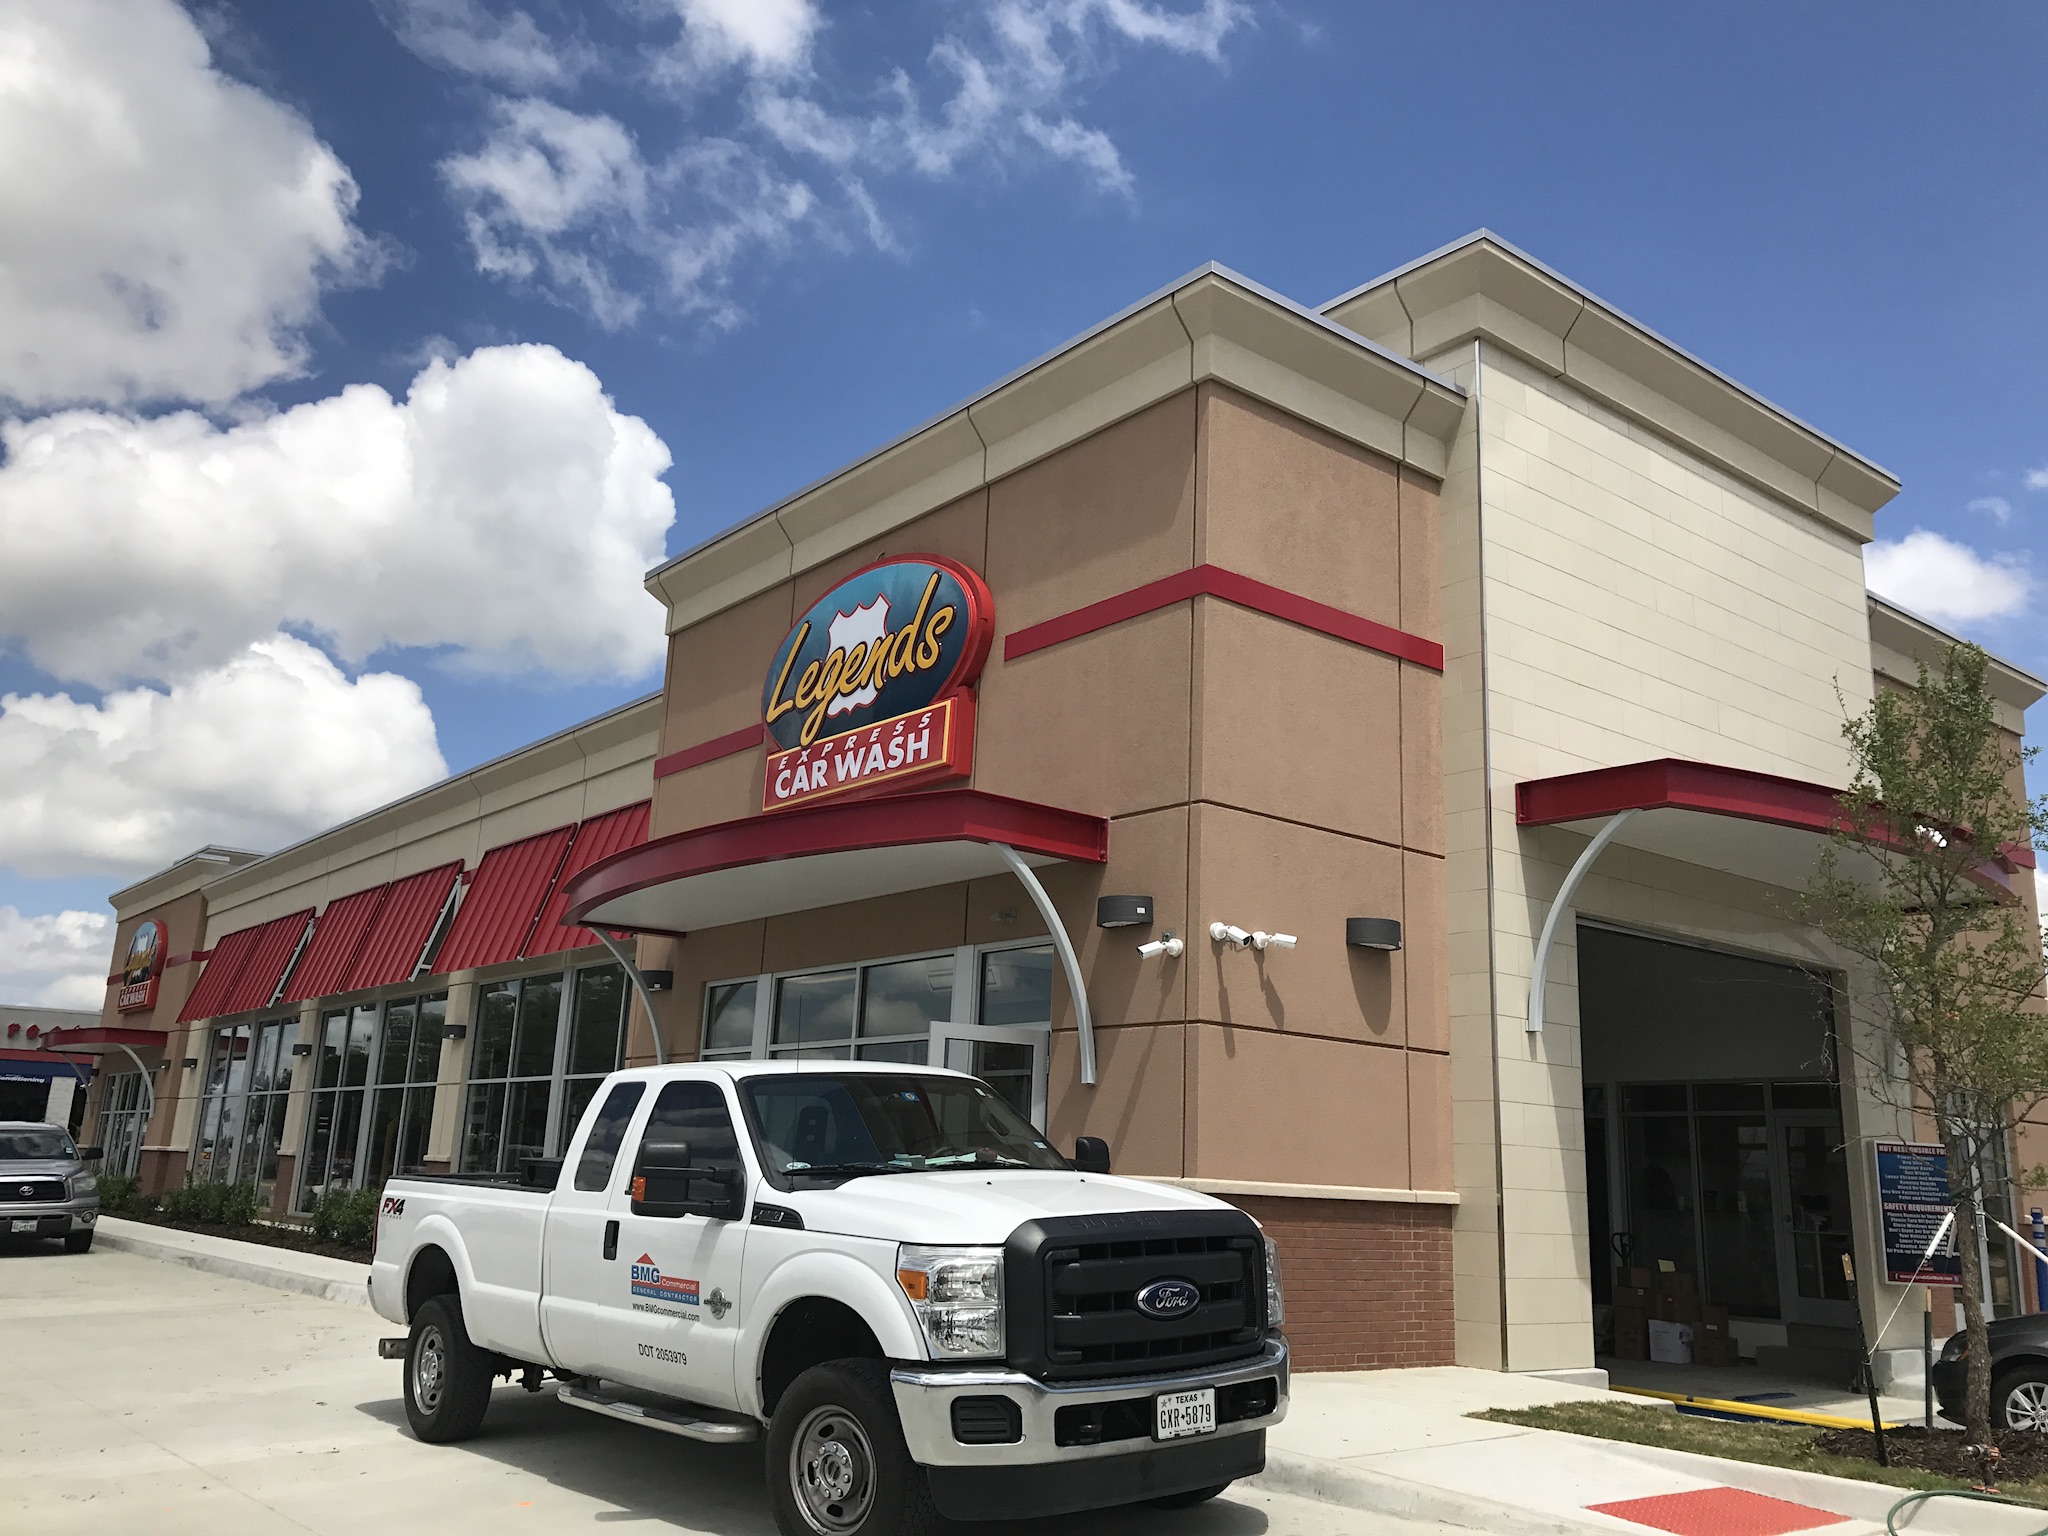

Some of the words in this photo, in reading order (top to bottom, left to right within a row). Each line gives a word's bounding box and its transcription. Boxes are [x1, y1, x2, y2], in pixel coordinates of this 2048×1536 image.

[766, 570, 956, 747] Legends
[778, 712, 933, 770] EXPRESS
[775, 759, 828, 799] CAR
[834, 728, 931, 783] WASH
[381, 1197, 406, 1216] FX4
[631, 1264, 660, 1284] BMG
[661, 1278, 697, 1291] Commercial
[632, 1286, 657, 1296] GENERAL
[659, 1290, 698, 1303] CONTRACTOR
[1155, 1287, 1189, 1309] Ford
[632, 1302, 701, 1323] www.BMGcommercial.com
[638, 1343, 655, 1358] DOT
[655, 1348, 688, 1366] 2053979
[1175, 1393, 1198, 1405] TEXAS
